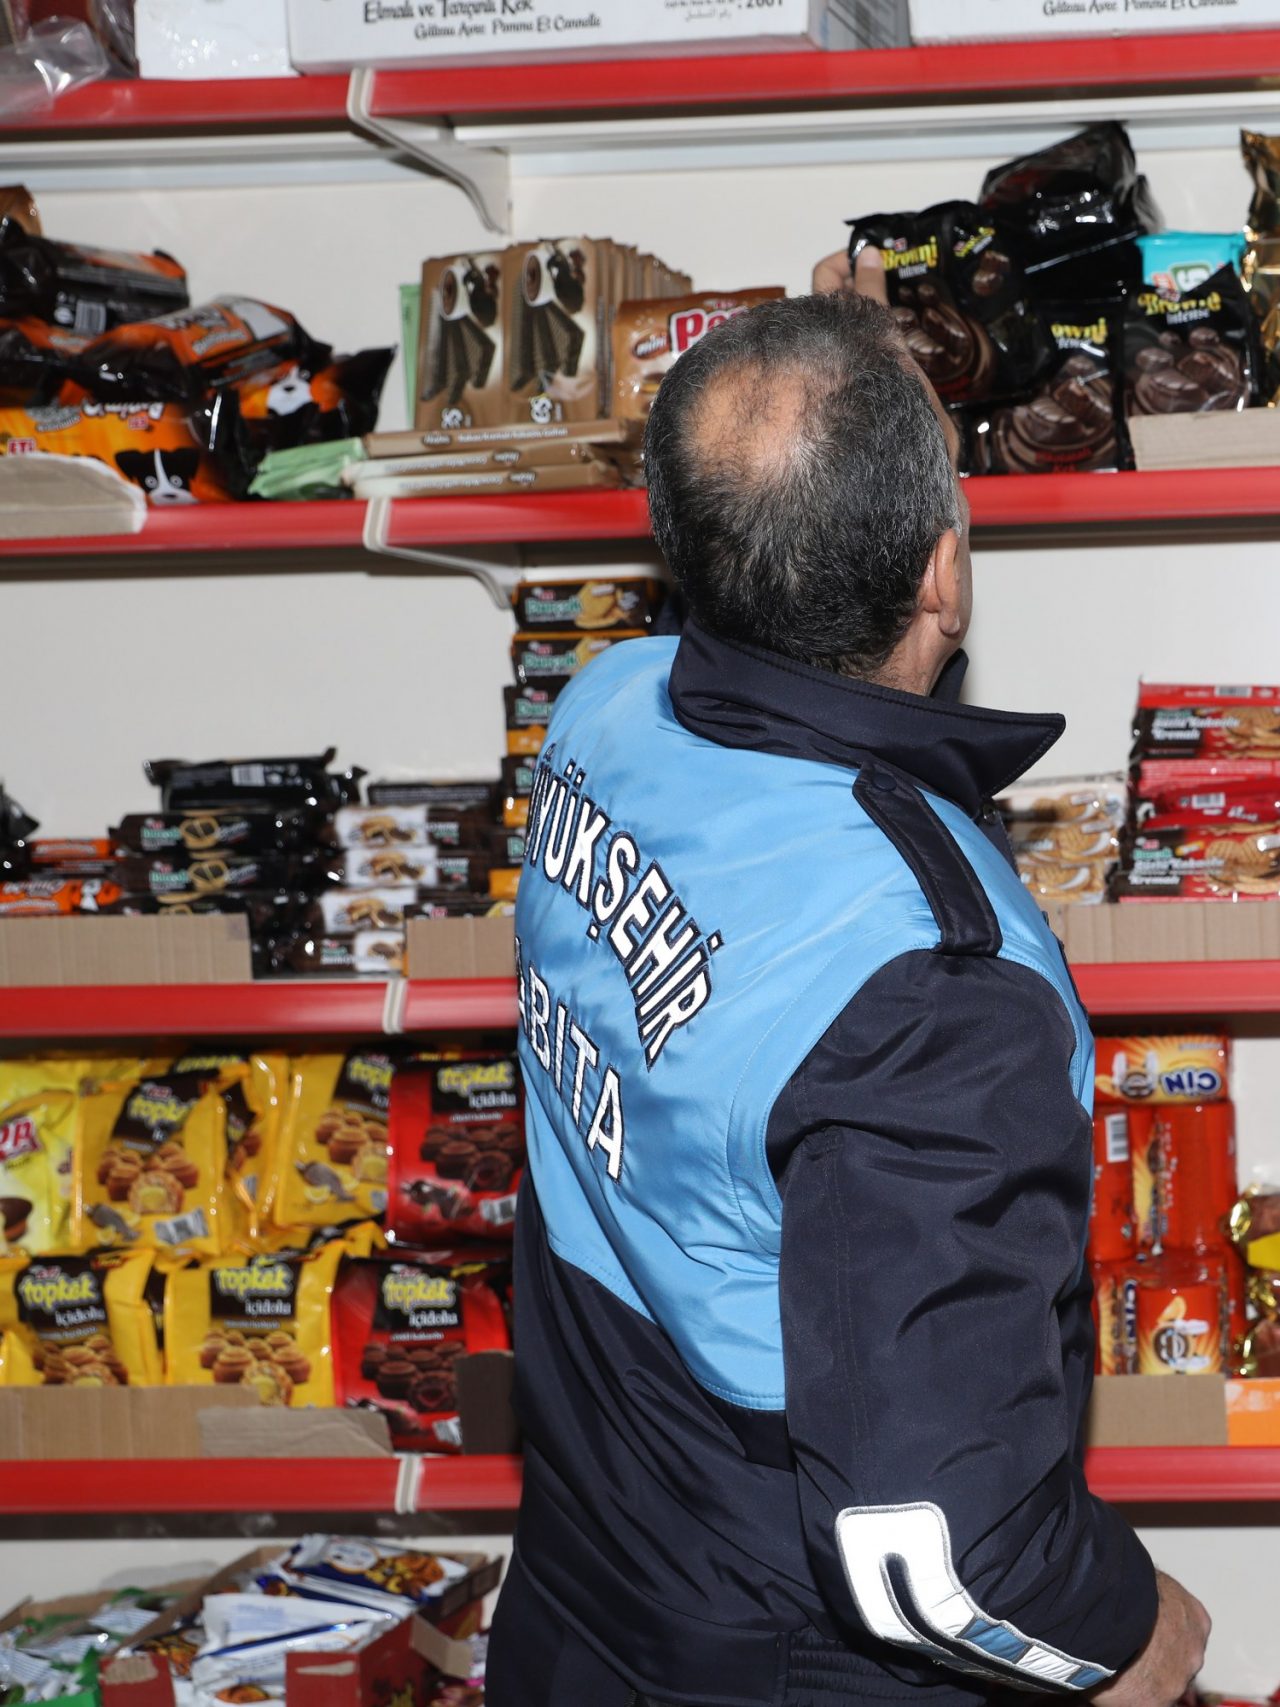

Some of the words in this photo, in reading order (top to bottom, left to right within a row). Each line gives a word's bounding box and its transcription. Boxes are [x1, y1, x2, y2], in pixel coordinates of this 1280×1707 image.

[418, 1, 434, 17] ve
[458, 22, 485, 38] Avec
[492, 19, 533, 34] Pomme
[636, 335, 667, 355] mini
[523, 741, 724, 1072] YÜKŞEHİR
